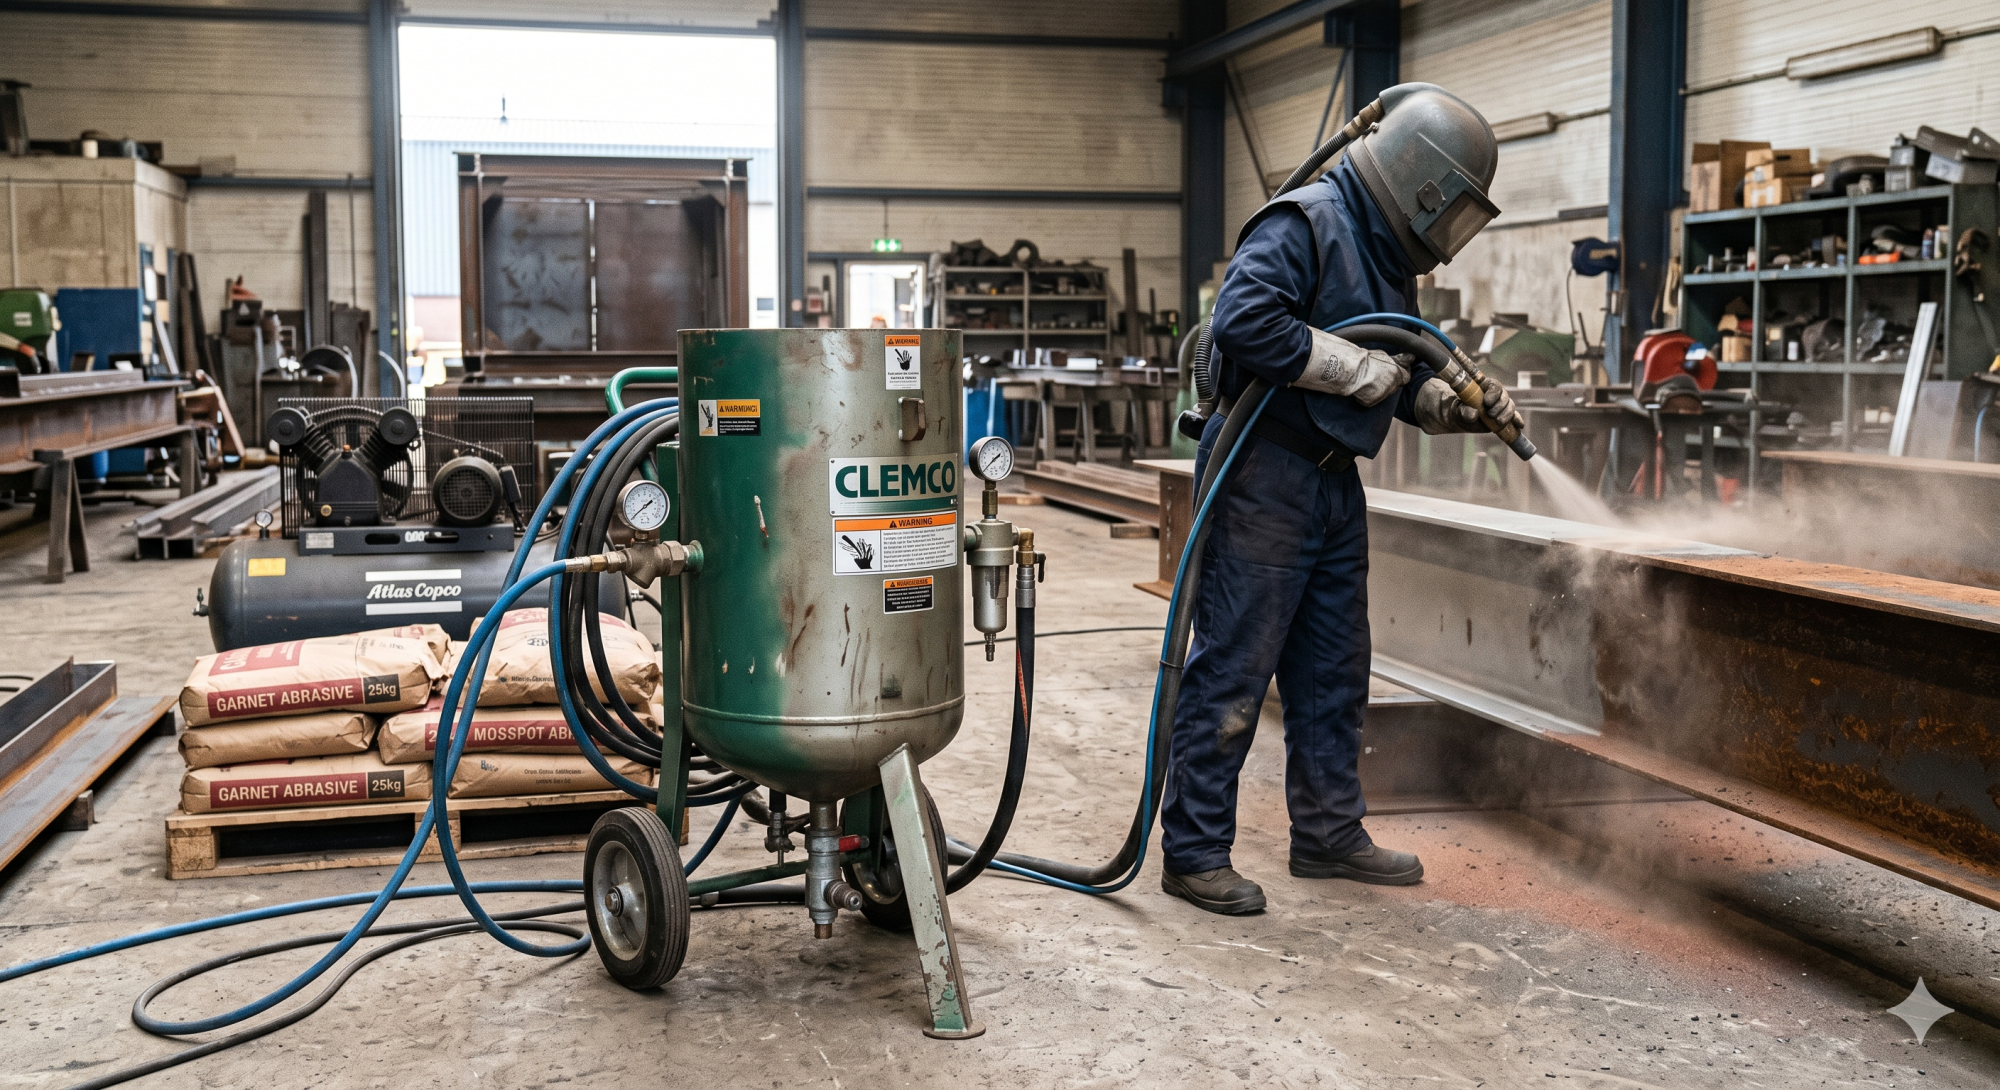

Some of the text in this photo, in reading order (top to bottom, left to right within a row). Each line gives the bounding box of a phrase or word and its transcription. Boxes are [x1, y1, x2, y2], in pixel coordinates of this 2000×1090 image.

[835, 460, 956, 498] CLEMCO
[898, 517, 933, 527] WARNING
[366, 582, 462, 601] Atlas Copco
[216, 685, 354, 712] GARNET ABRASIVE
[367, 682, 397, 698] 25kg
[474, 726, 545, 741] MOSSPOT
[218, 780, 358, 802] GARNET ABRASIVE
[372, 778, 401, 792] 25kg
